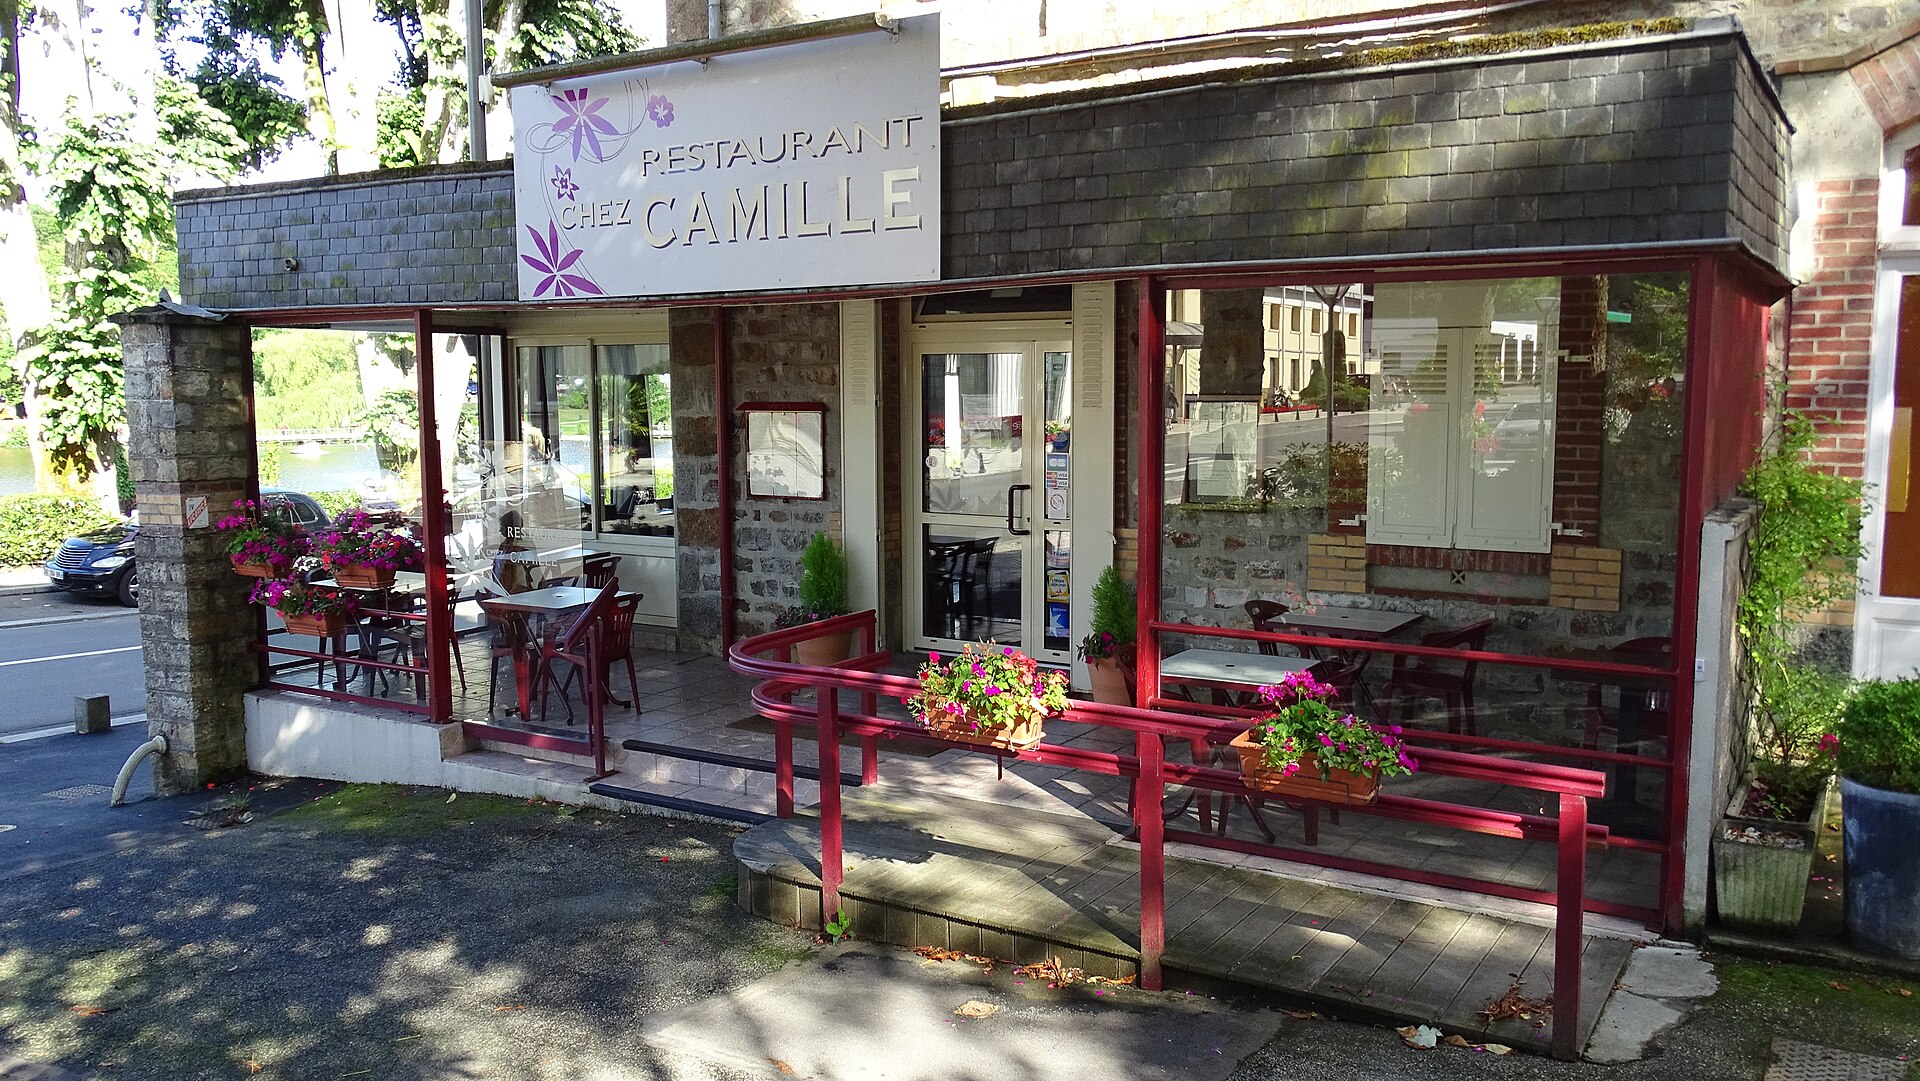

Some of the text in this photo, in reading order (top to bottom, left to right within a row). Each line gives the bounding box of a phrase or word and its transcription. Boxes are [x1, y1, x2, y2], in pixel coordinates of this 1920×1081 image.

[641, 114, 923, 177] RESTAURANT
[561, 166, 923, 249] CHEZ CAMILLE
